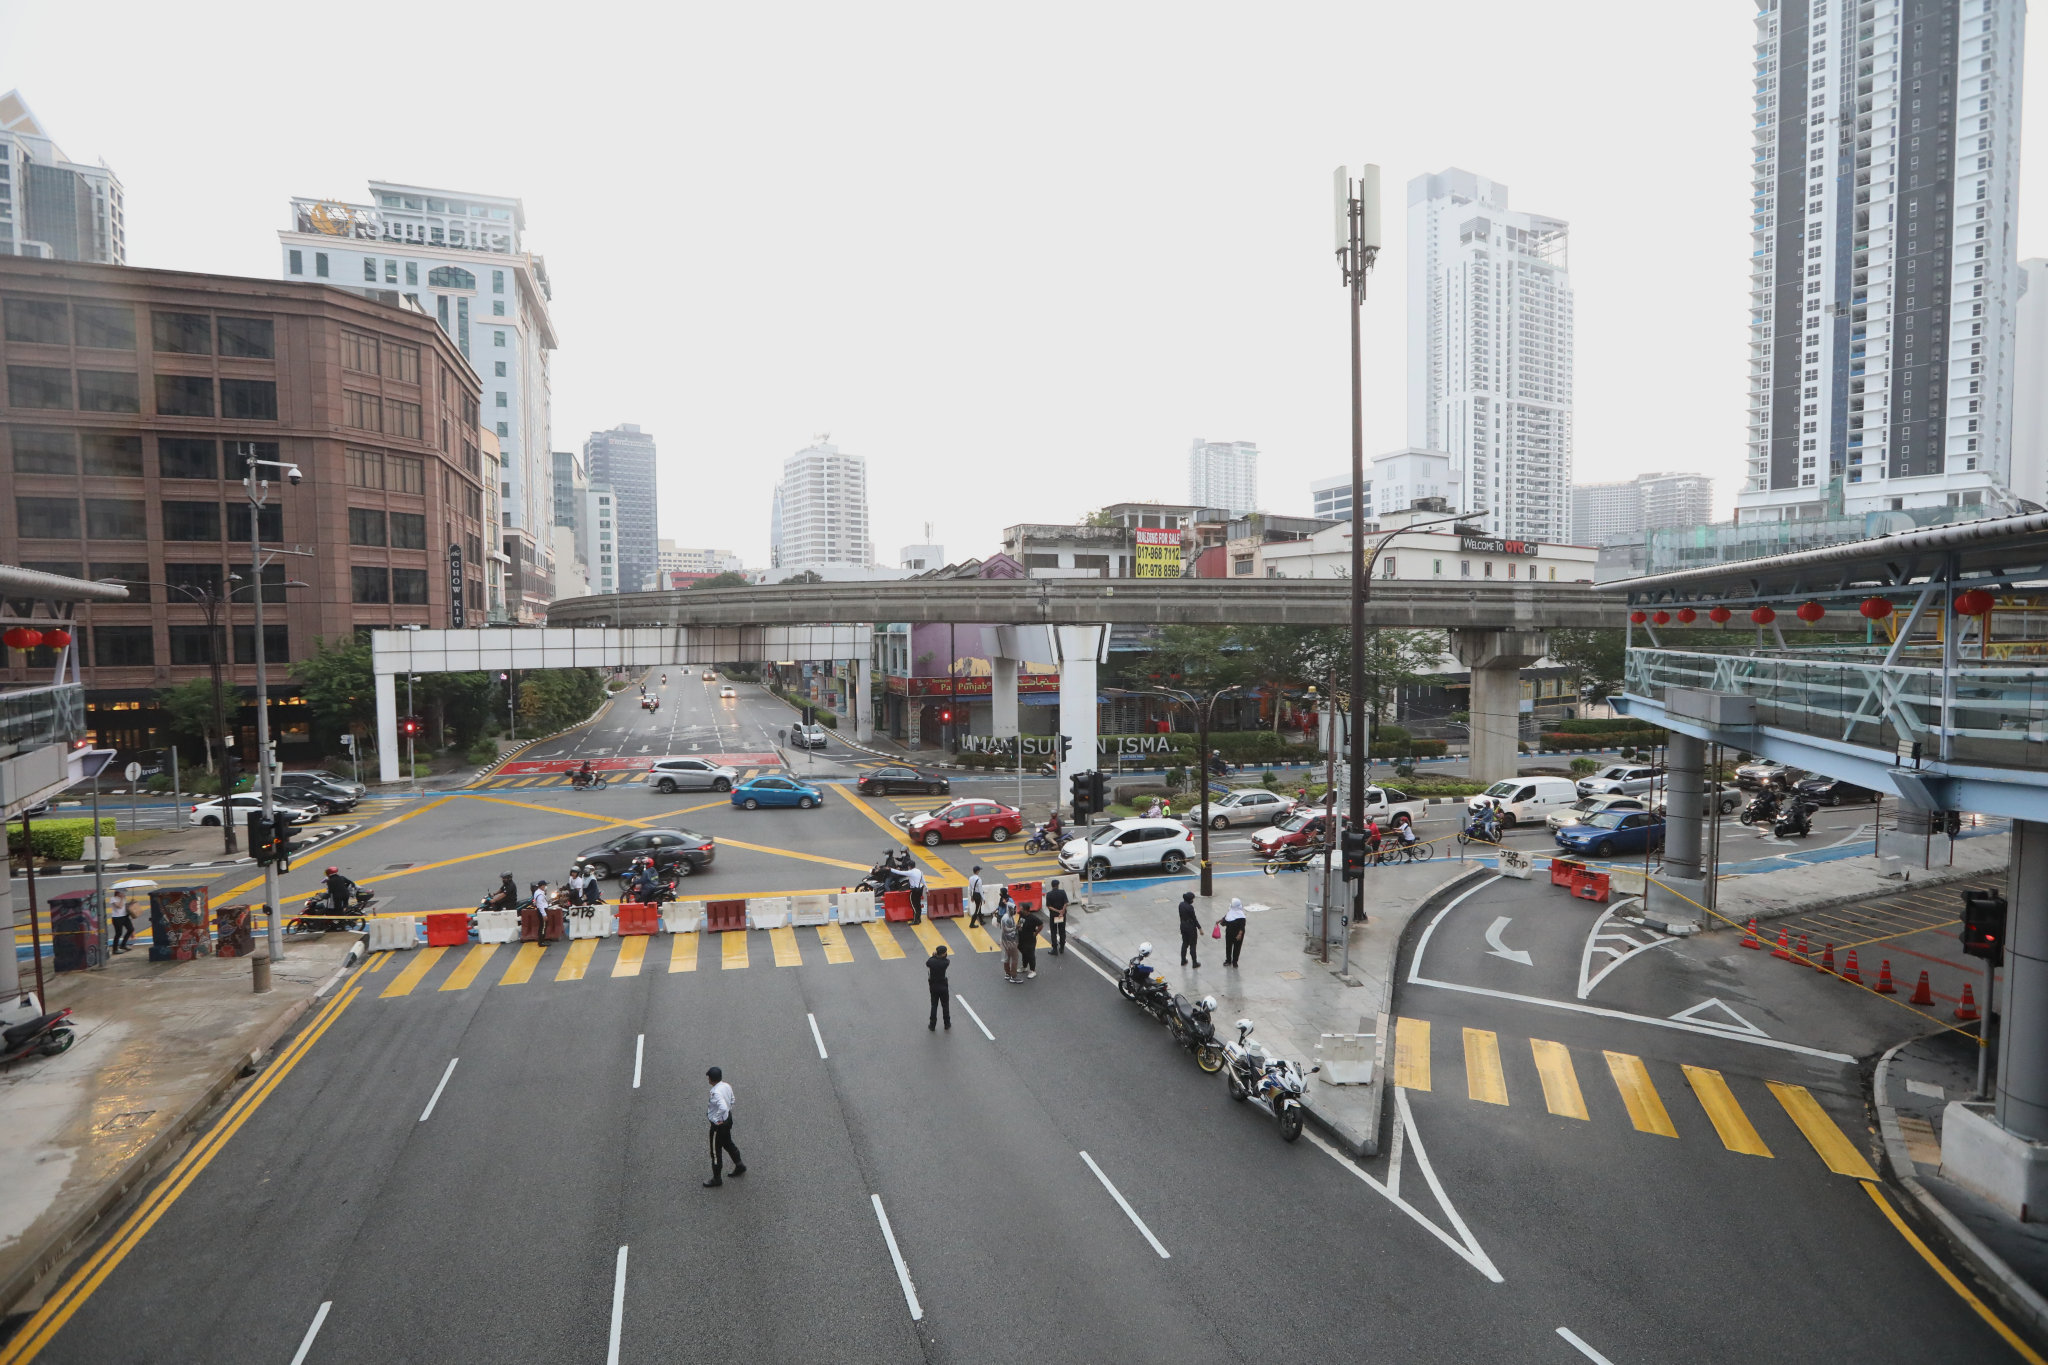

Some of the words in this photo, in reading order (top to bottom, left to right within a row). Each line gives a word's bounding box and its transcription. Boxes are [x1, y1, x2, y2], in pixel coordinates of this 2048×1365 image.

[1137, 531, 1159, 545] BUILDING
[1159, 532, 1169, 545] FOR
[1169, 533, 1180, 545] SALE
[1137, 546, 1162, 560] 017-968
[1164, 547, 1180, 560] 7112
[1137, 562, 1162, 577] 017-978
[1164, 564, 1180, 577] 8569
[452, 561, 461, 593] CHOW
[453, 600, 461, 624] KIT
[958, 682, 987, 692] Punjab
